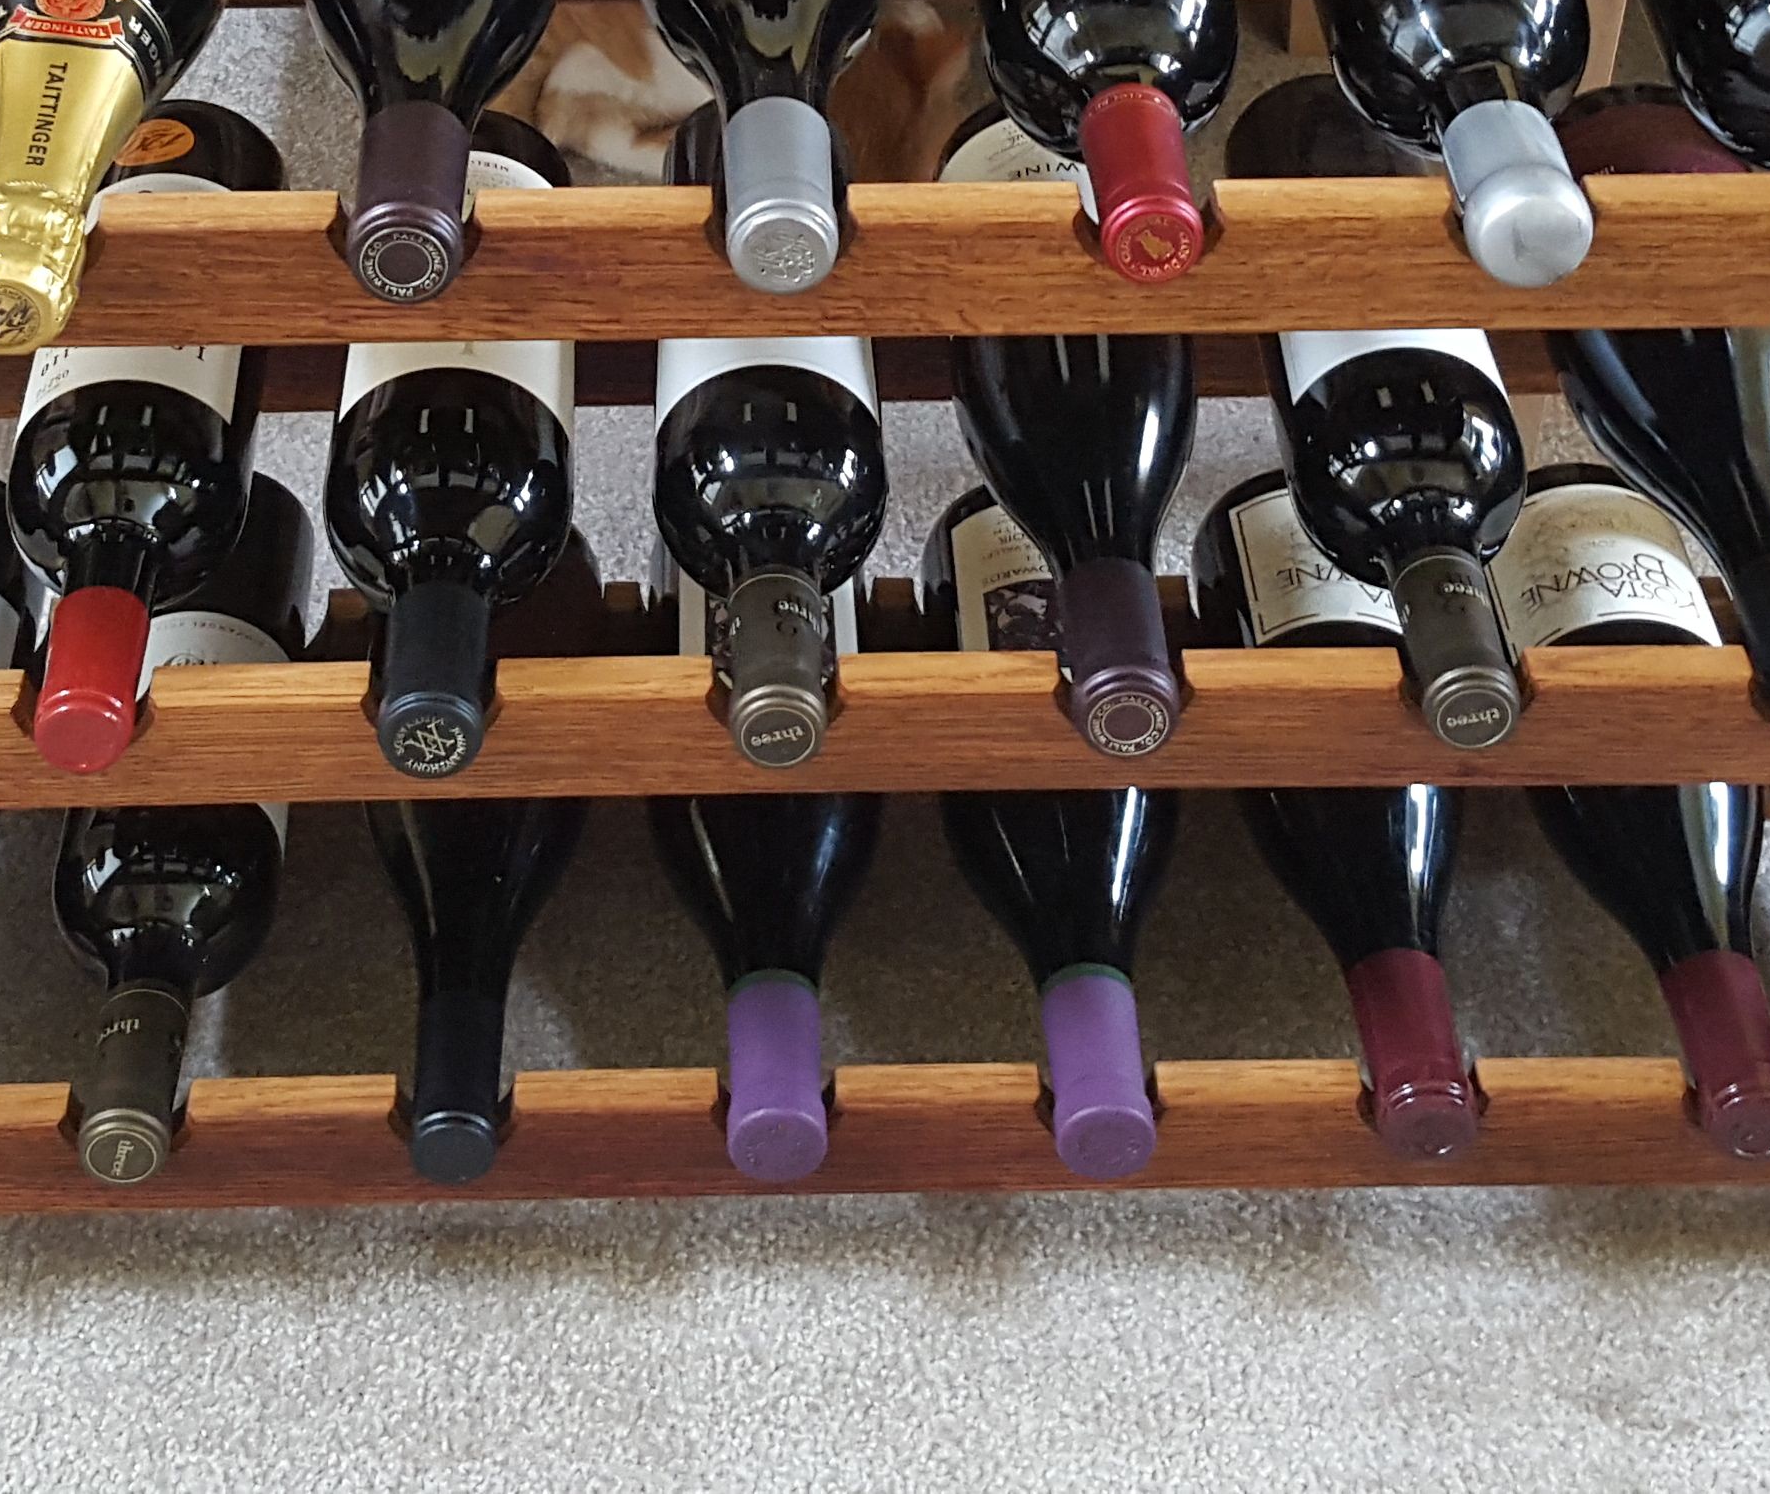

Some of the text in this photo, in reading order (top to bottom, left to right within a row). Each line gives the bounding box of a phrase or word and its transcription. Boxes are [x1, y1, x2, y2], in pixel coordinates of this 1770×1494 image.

[23, 19, 107, 38] TAITTINGER
[25, 62, 68, 167] TAITTINGER
[384, 283, 415, 297] PALI
[1518, 553, 1670, 617] BROWNE
[1445, 707, 1501, 729] three
[750, 725, 805, 748] three
[1108, 741, 1136, 753] PALI
[110, 1139, 135, 1177] three
